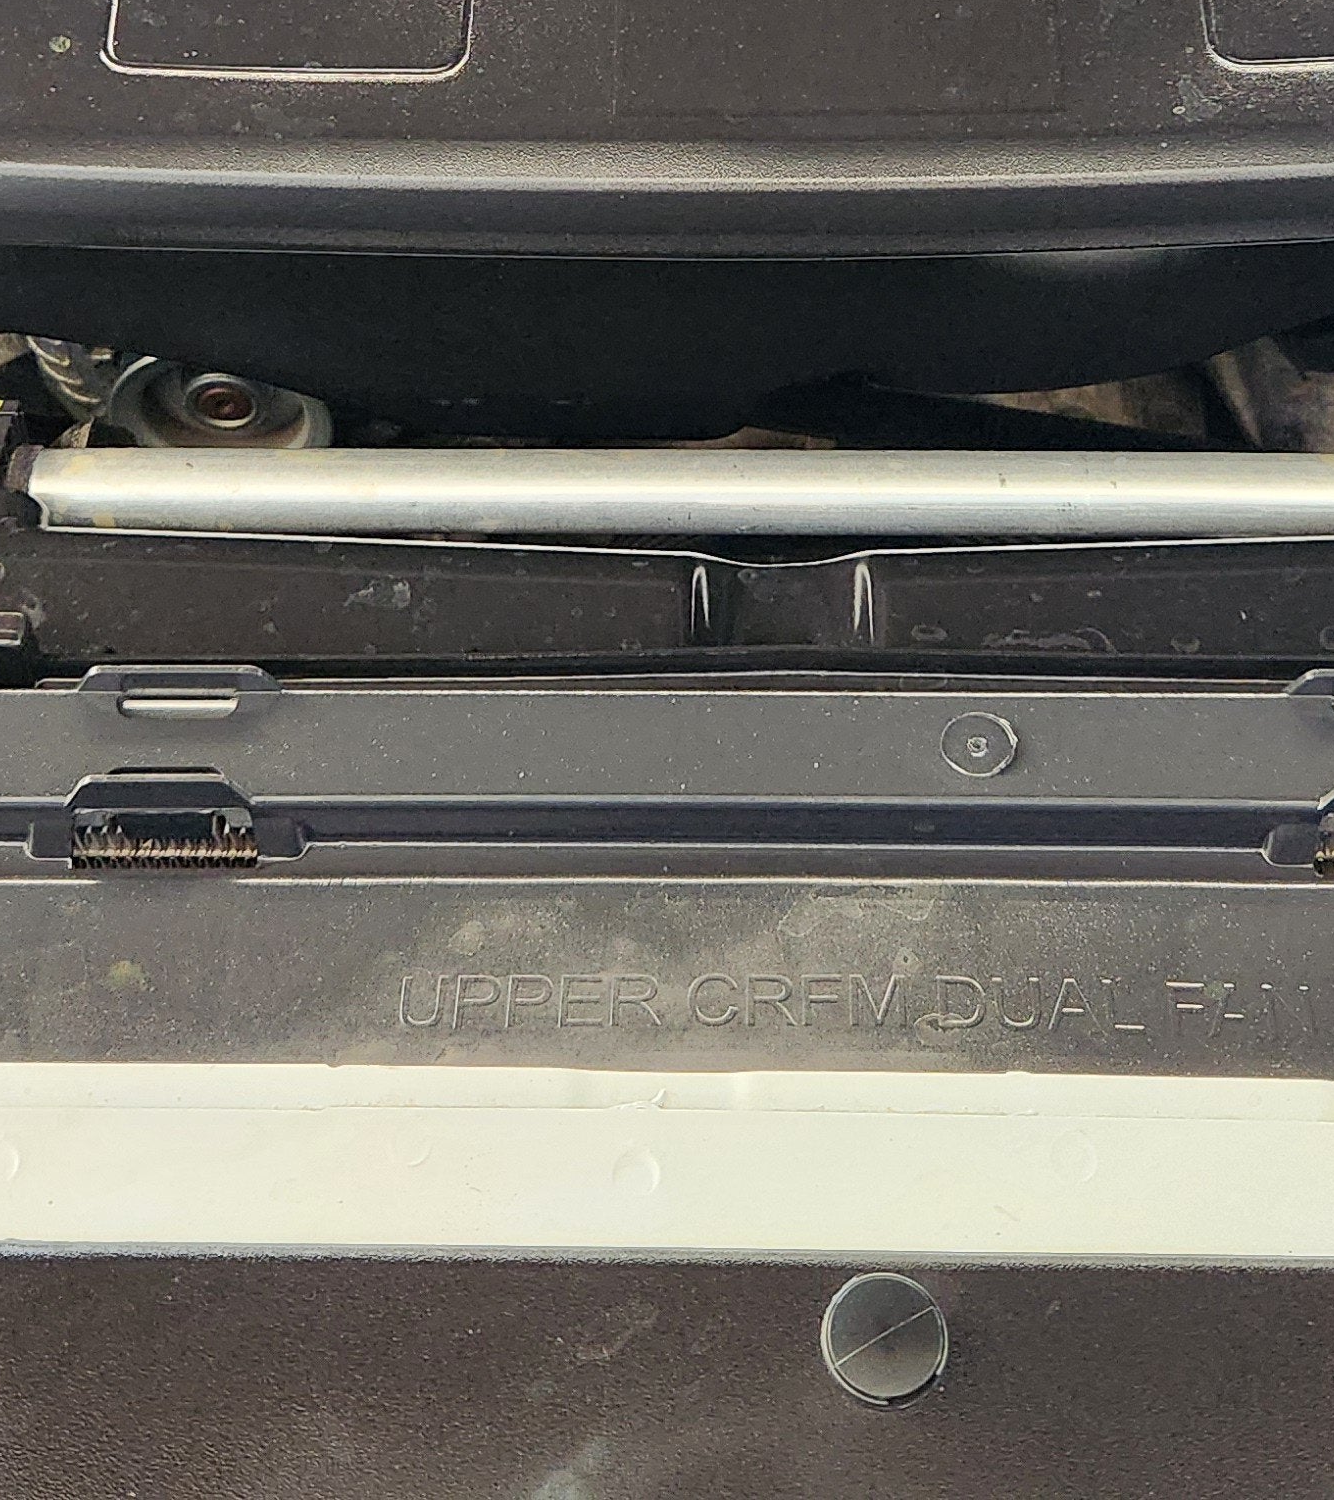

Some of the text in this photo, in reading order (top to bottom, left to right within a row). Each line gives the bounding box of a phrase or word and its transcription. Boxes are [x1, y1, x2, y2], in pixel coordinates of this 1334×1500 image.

[399, 972, 1317, 1035] UPPER CRFM DUAL FAN
